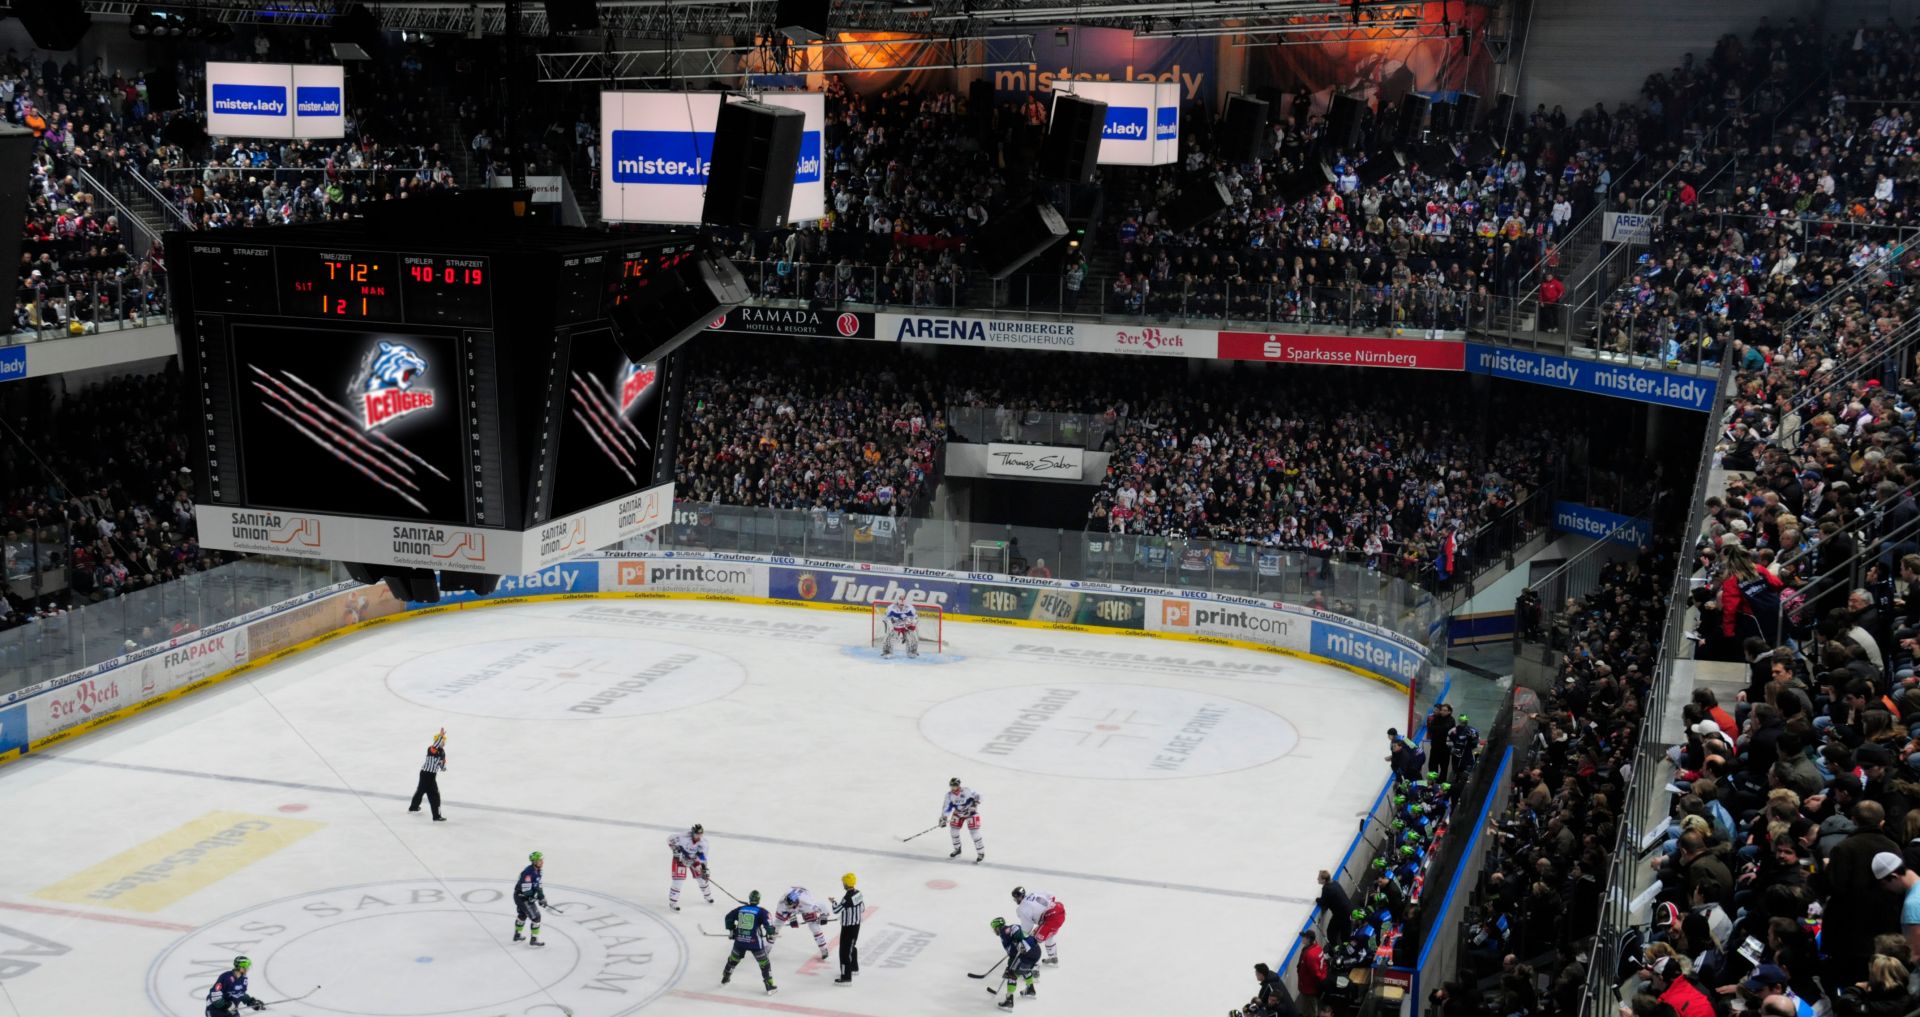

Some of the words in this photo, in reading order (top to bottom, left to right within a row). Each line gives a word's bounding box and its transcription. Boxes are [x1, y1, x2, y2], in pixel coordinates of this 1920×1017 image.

[193, 246, 221, 254] SPIELER
[233, 248, 269, 257] STRAFZEIT
[320, 252, 352, 261] TIME/ZEIT
[405, 257, 433, 265] SPIELER
[446, 259, 483, 268] STRAFZEIT
[361, 286, 385, 296] MAN
[742, 308, 821, 324] RAMADA
[746, 323, 774, 331] HOTELS
[896, 318, 987, 343] ARENA
[989, 322, 1074, 335] NÜRNBERGER
[989, 334, 1075, 345] VERSICHERUNG
[1116, 331, 1141, 344] Der
[1142, 328, 1183, 349] Beck
[1287, 347, 1351, 362] Sparkasse
[1355, 350, 1417, 367] Nürnberg
[992, 451, 1036, 470] Thomas
[1033, 455, 1078, 471] Sabo
[619, 497, 642, 515] SANITÄR
[231, 512, 282, 529] SANITÄR
[877, 520, 890, 531] 19
[232, 527, 269, 541] UNION
[393, 526, 444, 543] SANITÄR
[541, 522, 567, 542] SANITÄR
[393, 541, 431, 556] UNION
[968, 573, 994, 581] IVECO
[982, 591, 1018, 611] JEVER
[1181, 591, 1207, 599] IVECO
[1041, 594, 1072, 618] JEVER
[1096, 600, 1133, 621] JEVER
[164, 636, 225, 669] FRAPACK
[98, 659, 119, 671] IVECO
[50, 700, 75, 719] Der
[77, 680, 119, 714] Beck
[302, 888, 503, 919] SABO
[738, 912, 755, 930] 19
[556, 900, 654, 996] CHARM
